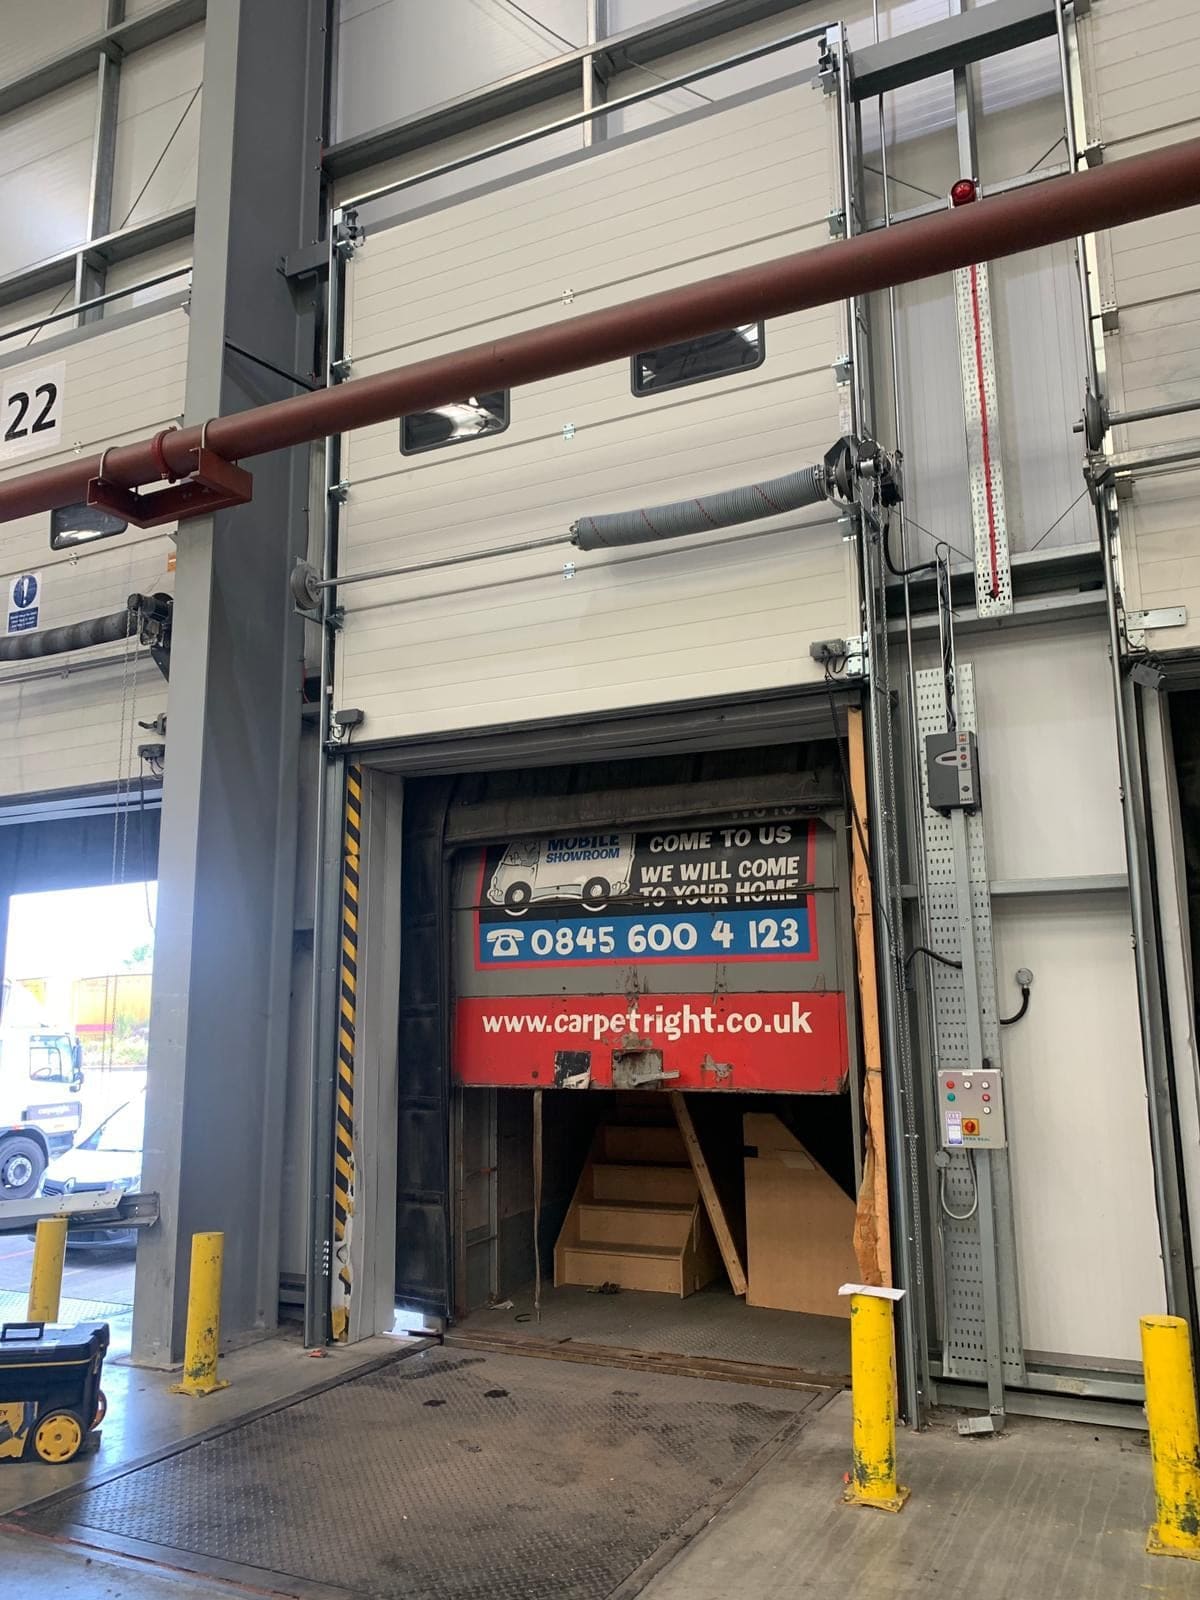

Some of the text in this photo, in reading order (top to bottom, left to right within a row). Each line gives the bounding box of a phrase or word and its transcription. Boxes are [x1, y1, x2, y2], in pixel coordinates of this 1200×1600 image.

[5, 383, 57, 442] 22
[547, 834, 619, 851] MOBILE
[650, 826, 791, 853] COME TO US
[546, 848, 619, 864] SHOWROOM
[641, 856, 800, 884] WE WILL COME
[640, 879, 798, 907] TO YOUR HOME
[531, 918, 799, 955] 0845 600 4 123
[482, 1002, 813, 1041] www.carpetright.co.uk
